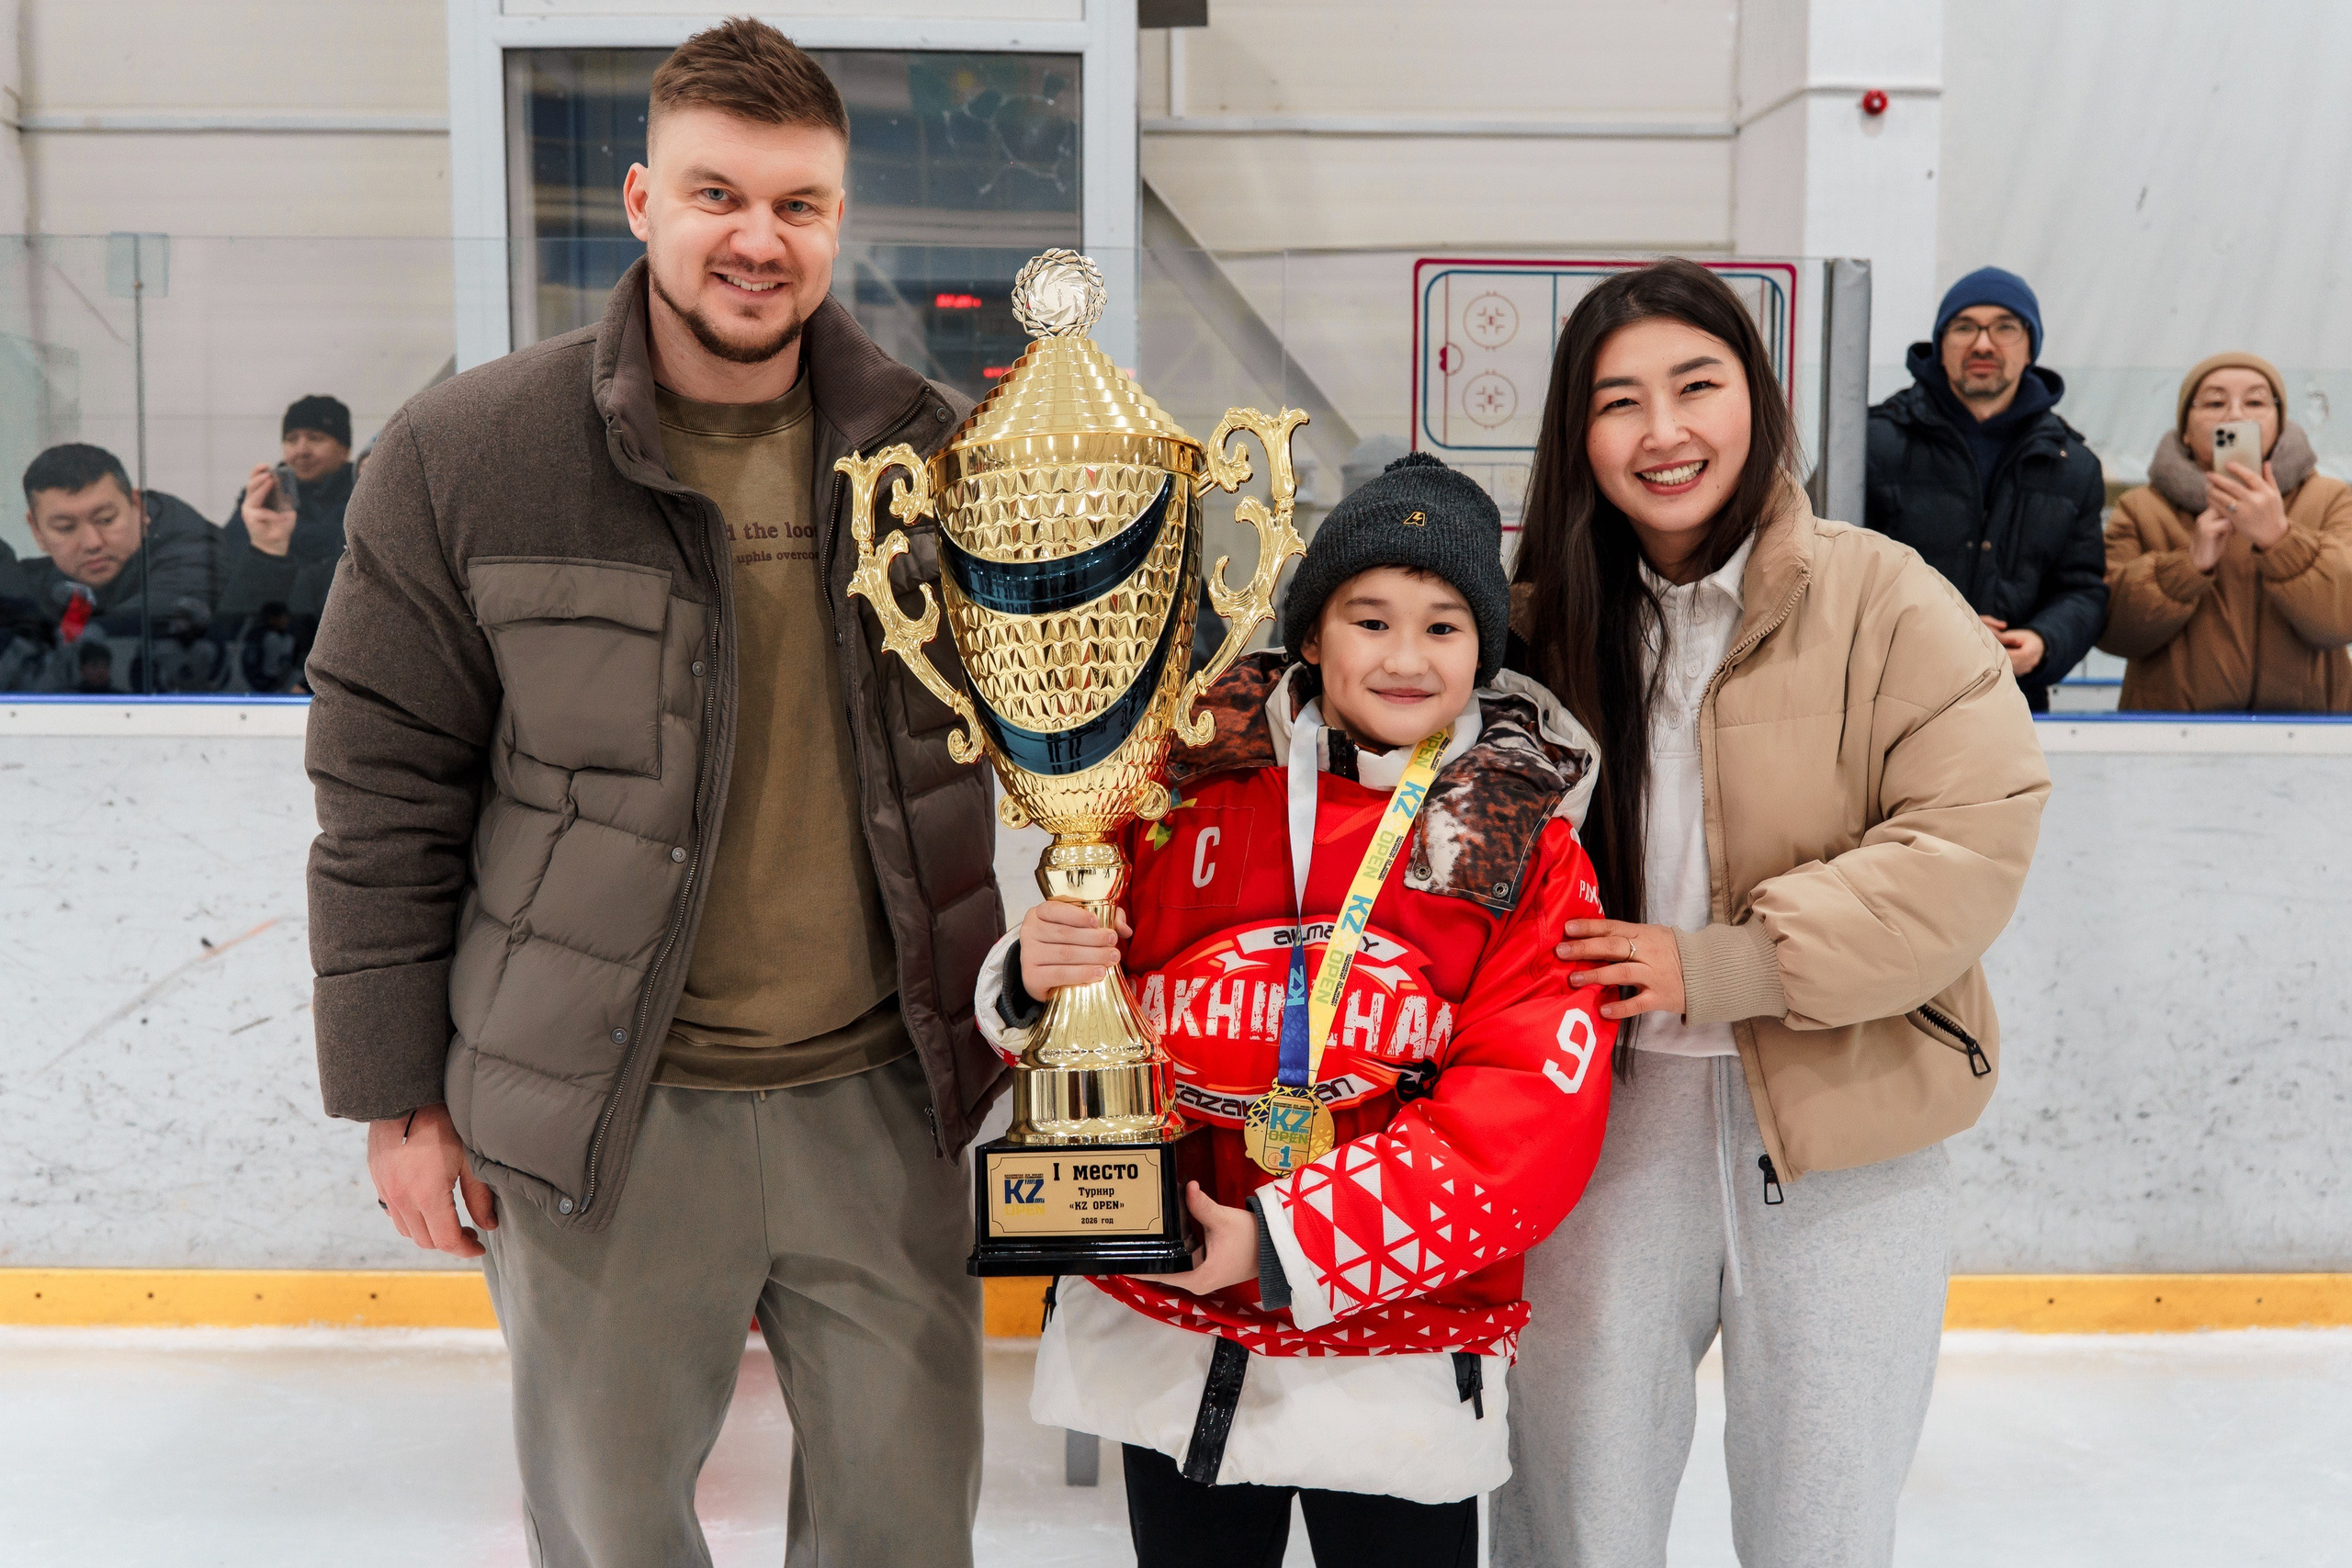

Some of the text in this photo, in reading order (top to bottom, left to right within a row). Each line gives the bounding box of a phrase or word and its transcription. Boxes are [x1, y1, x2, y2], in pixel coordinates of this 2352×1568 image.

[743, 521, 778, 540] the
[785, 521, 818, 538] loo
[1391, 781, 1427, 818] KZ
[1193, 826, 1220, 888] C
[1363, 829, 1396, 879] OPEN
[1341, 894, 1374, 934] KZ
[1286, 965, 1305, 1007] KZ
[1315, 949, 1345, 1004] OPEN
[1542, 1008, 1597, 1094] 9
[1269, 1106, 1312, 1134] KZ
[1268, 1130, 1309, 1145] OPEN
[1278, 1145, 1292, 1168] 1
[1073, 1163, 1138, 1180] место
[1004, 1179, 1045, 1204] KZ
[1078, 1187, 1115, 1198] Турнир
[1005, 1203, 1045, 1216] OPEN
[1069, 1201, 1125, 1211] «KZ OPEN»
